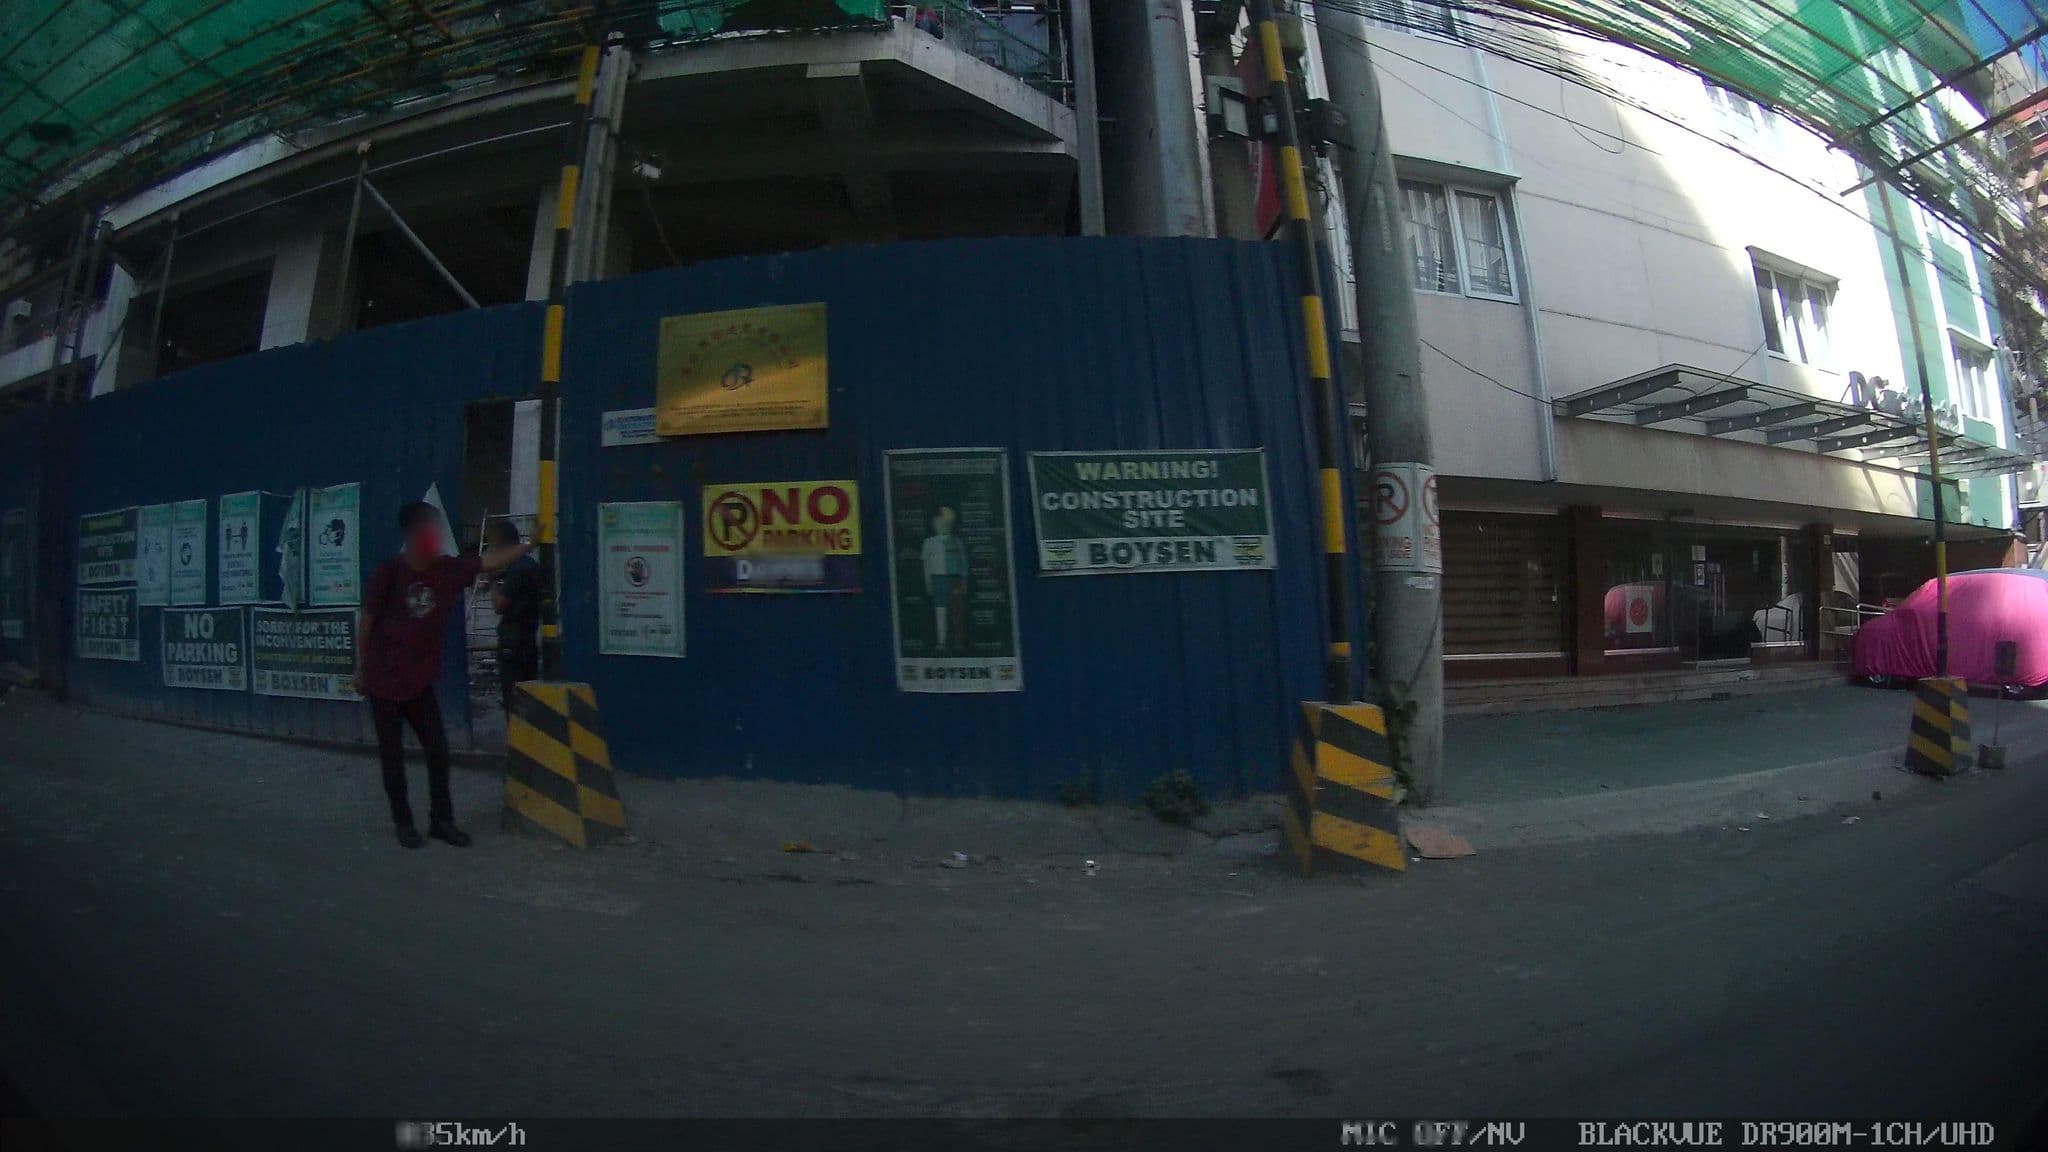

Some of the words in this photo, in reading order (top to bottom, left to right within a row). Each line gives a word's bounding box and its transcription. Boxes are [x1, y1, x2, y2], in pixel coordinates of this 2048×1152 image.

[1074, 460, 1219, 481] WARNING!
[762, 486, 850, 525] NO
[1041, 488, 1259, 511] CONSTRUCTION
[1121, 510, 1185, 529] SITE
[763, 527, 853, 550] PARKING
[1089, 540, 1216, 565] BOYSEN
[82, 614, 129, 636] FIRST
[184, 613, 214, 639] NO
[255, 620, 292, 634] SORRY
[295, 621, 318, 635] FOR
[323, 621, 350, 635] THE
[167, 642, 238, 664] PARKING
[255, 635, 352, 650] INCONVENIENCE
[271, 674, 330, 692] BOYSEN
[924, 666, 992, 681] BOYSEN
